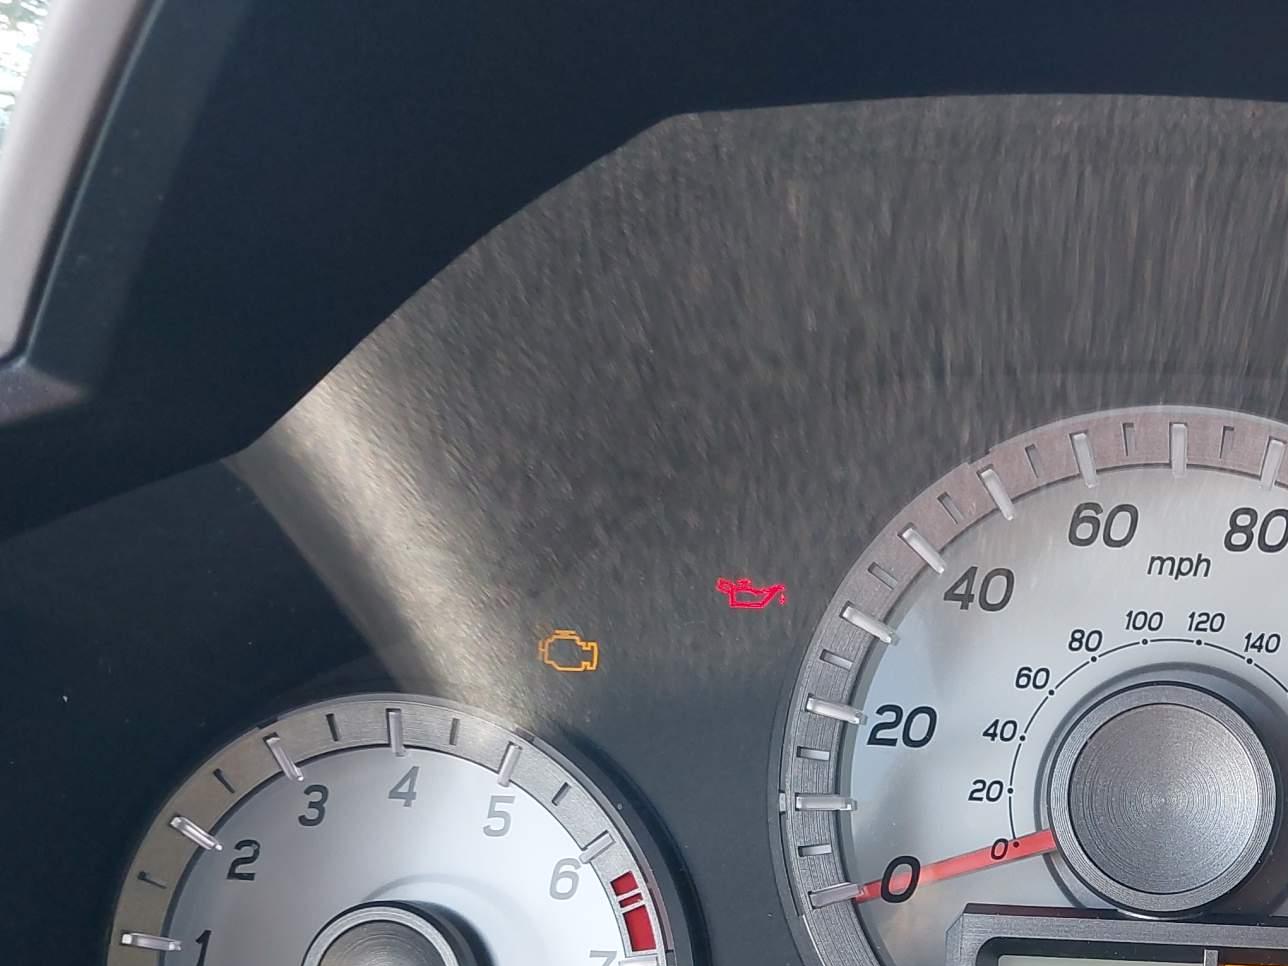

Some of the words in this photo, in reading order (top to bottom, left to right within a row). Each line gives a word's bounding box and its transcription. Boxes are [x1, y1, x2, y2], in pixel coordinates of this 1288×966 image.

[1067, 502, 1139, 548] 60
[1147, 554, 1211, 580] mph
[944, 566, 1015, 611] 40
[1124, 611, 1164, 633] 100
[1187, 612, 1226, 633] 120
[1067, 629, 1103, 653] 80
[1243, 632, 1281, 655] 140
[1014, 667, 1050, 691] 60
[866, 704, 937, 748] 20
[982, 720, 1018, 743] 40
[388, 765, 419, 807] 4
[967, 780, 1003, 803] 20
[298, 784, 329, 826] 3
[483, 795, 515, 837] 5
[227, 839, 261, 881] 2
[990, 838, 1009, 861] 0
[548, 857, 580, 899] 6
[880, 855, 921, 904] 0
